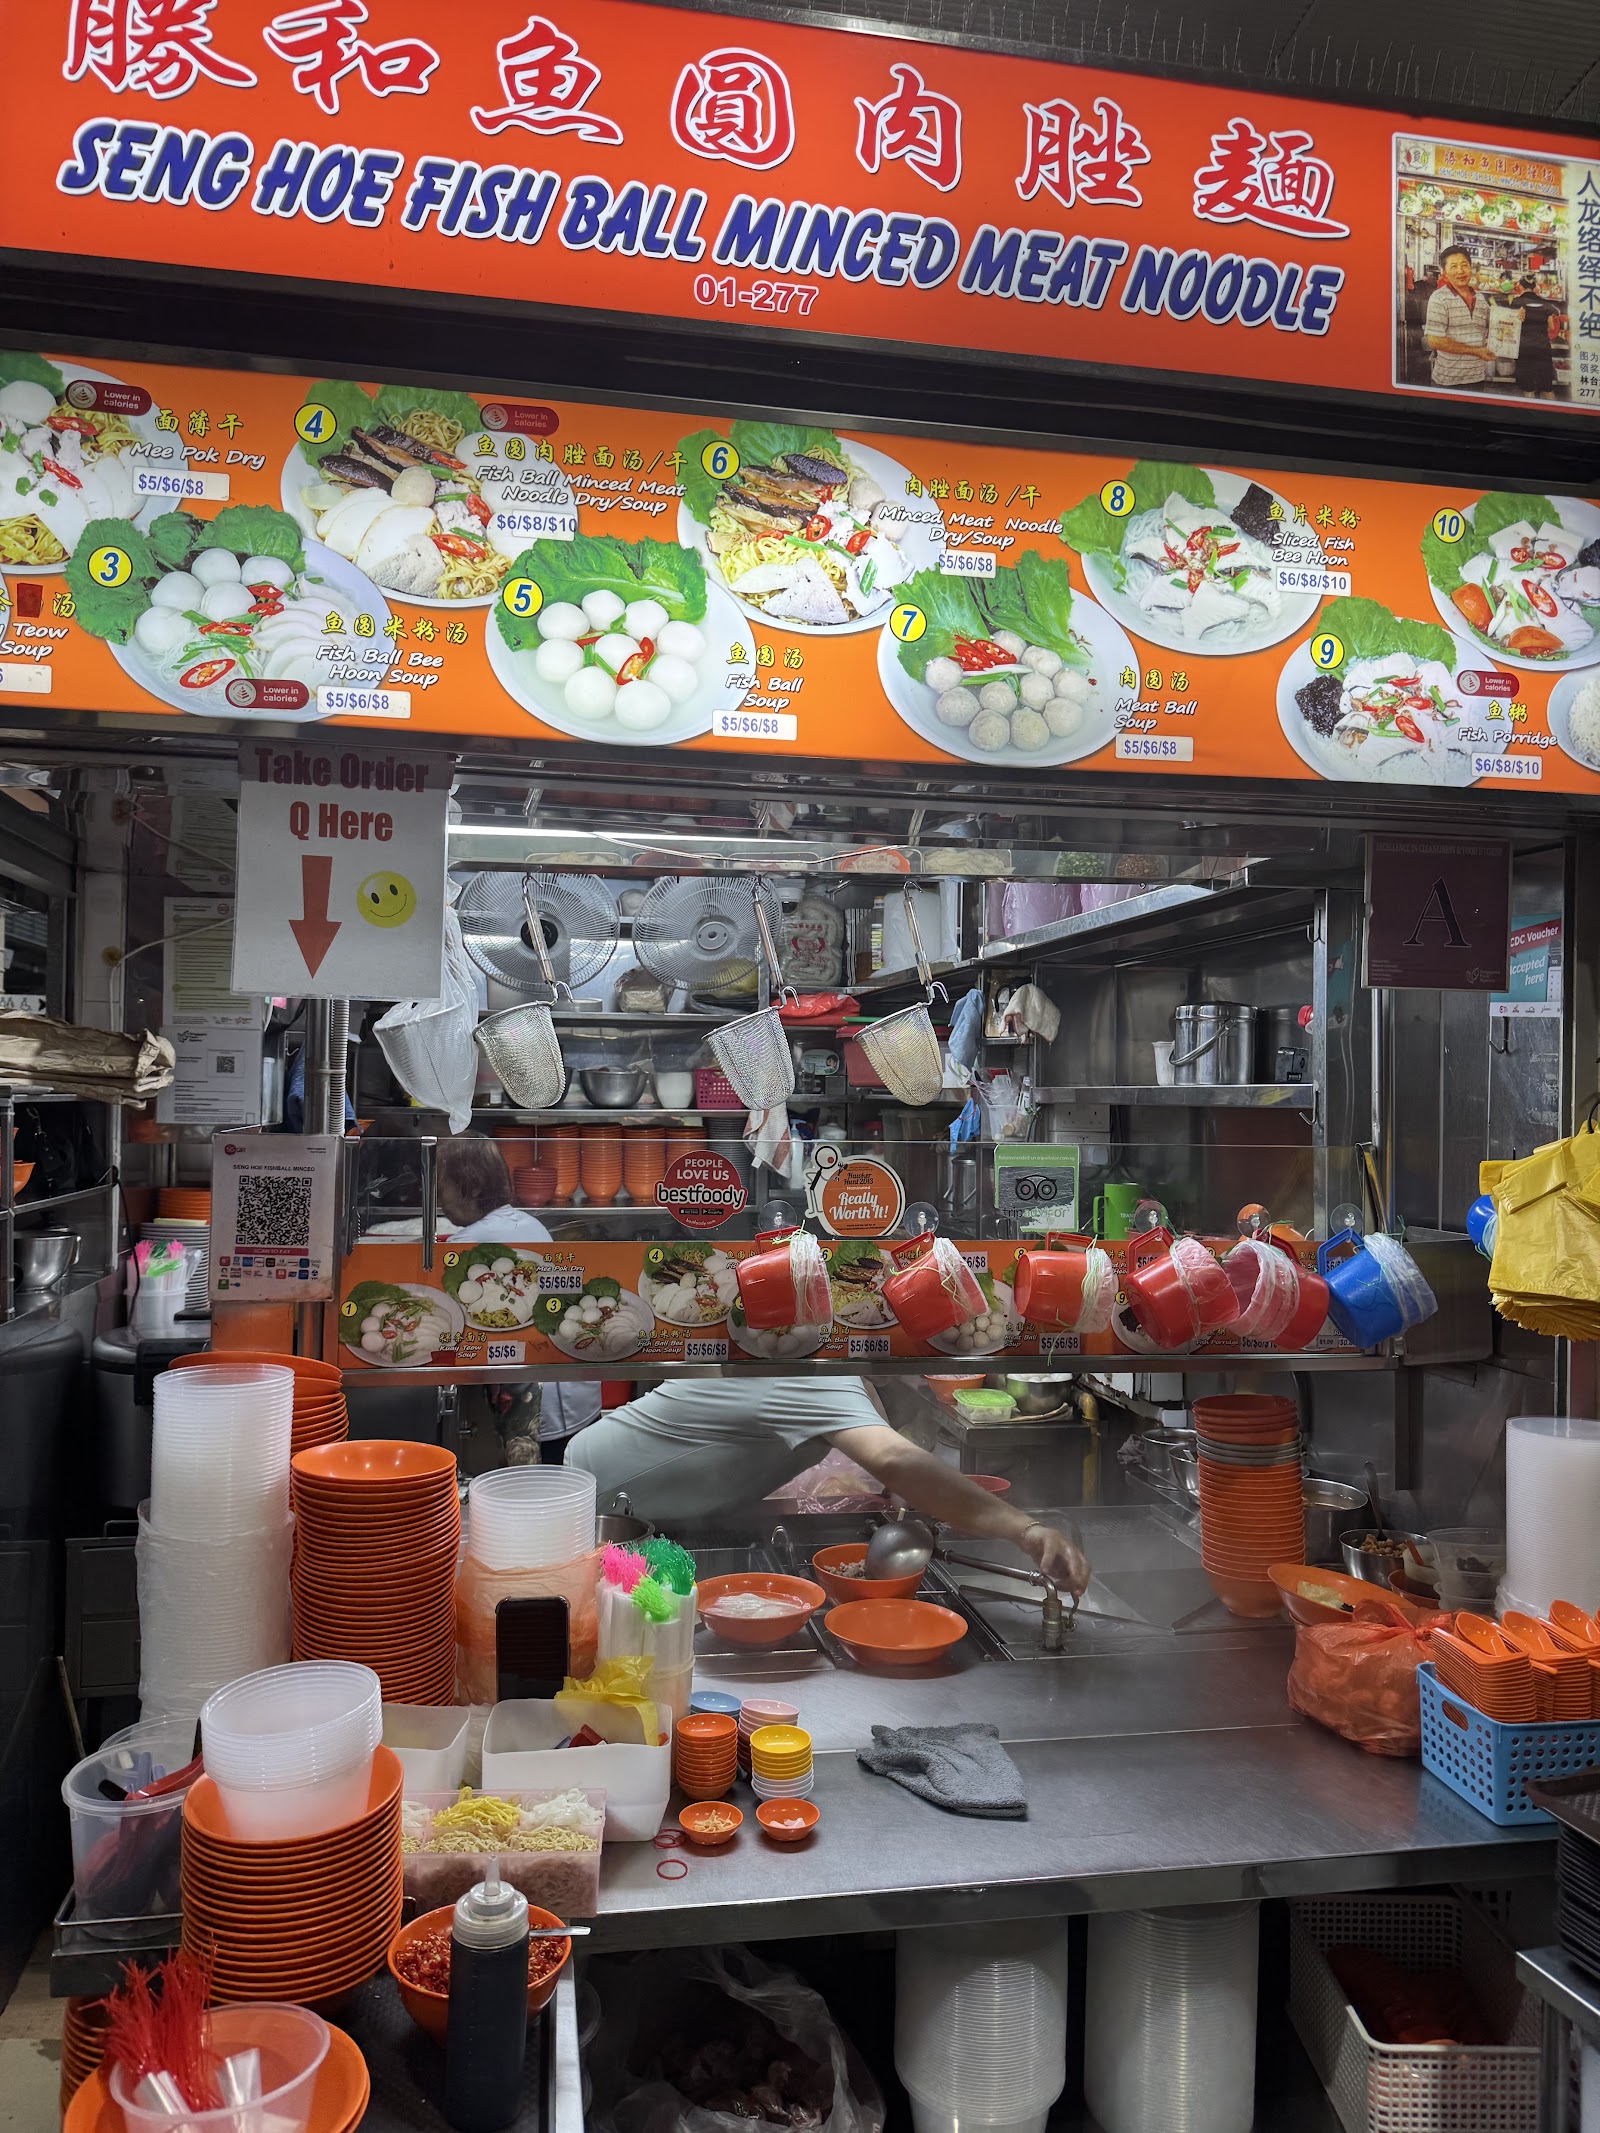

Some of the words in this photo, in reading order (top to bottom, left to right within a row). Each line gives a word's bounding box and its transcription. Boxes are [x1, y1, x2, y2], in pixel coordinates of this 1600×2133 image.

[57, 117, 255, 211] SENG
[252, 139, 402, 227] HOE
[400, 155, 558, 244] FISH
[558, 172, 711, 262] BALL
[712, 190, 956, 289] MINCED
[962, 224, 1130, 317] MEAT
[1124, 245, 1349, 338] NOODLE
[694, 274, 820, 316] 01-277
[1580, 375, 1600, 386] 林台
[103, 400, 139, 410] calories
[104, 390, 131, 400] Lower
[304, 411, 324, 438] 4
[514, 411, 539, 421] Lower
[541, 412, 548, 420] in
[514, 419, 547, 429] calories
[130, 443, 173, 460] Mee
[181, 447, 219, 463] Pok
[226, 451, 266, 471] Dry
[711, 446, 728, 474] 6
[138, 473, 204, 496] $5/$6/$8
[476, 465, 515, 483] Fish
[520, 468, 557, 487] Ball
[563, 472, 632, 493] Minced
[638, 478, 687, 497] Meat
[502, 485, 568, 506] Noodle
[575, 492, 668, 517] Dry/Soup
[1109, 485, 1125, 512] 8
[497, 513, 577, 533] $6/$8/$10
[879, 506, 943, 525] Minced
[948, 512, 994, 529] Meat
[1005, 517, 1064, 535] Noodle
[1437, 514, 1460, 537] 10
[929, 527, 1015, 551] Dry/Soup
[1272, 531, 1318, 549] Sliced
[1324, 537, 1355, 550] Fish
[99, 552, 118, 582] 3
[938, 553, 993, 573] $5/$6/$8
[1272, 549, 1301, 563] Bee
[1306, 552, 1349, 566] Hoon
[1279, 571, 1347, 590] $6/$8/$10
[514, 584, 533, 613] 5
[13, 622, 69, 640] Teow
[321, 610, 469, 645] 鱼圆米粉汤
[900, 610, 917, 637] 7
[0, 641, 54, 662] Soup
[316, 645, 355, 662] Fish
[363, 648, 402, 665] Ball
[409, 651, 444, 668] Bee
[726, 641, 804, 670] 鱼圆汤
[1320, 638, 1335, 665] 9
[329, 666, 382, 683] Hoon
[389, 669, 438, 690] Soup
[725, 673, 761, 690] Fish
[767, 676, 803, 693] Ball
[1118, 667, 1190, 692] 肉圆汤
[1485, 677, 1505, 686] Lower
[263, 685, 289, 694] Lower
[290, 686, 299, 694] in
[263, 693, 298, 703] calories
[1484, 684, 1511, 693] calories
[326, 693, 390, 710] $5/$6/$8
[744, 694, 789, 713] Soup
[1114, 698, 1159, 714] Meat
[1164, 700, 1198, 715] Ball
[721, 716, 779, 734] $5/$6/$8
[1114, 715, 1157, 734] Soup
[1124, 739, 1177, 756] $5/$6/$8
[1458, 728, 1488, 743] Fish
[1493, 730, 1558, 749] Porridge
[255, 748, 332, 786] Take
[340, 752, 429, 792] Order
[1475, 757, 1539, 775] $6/$8/$10
[289, 800, 310, 841] Q
[318, 803, 393, 842] Here
[1403, 877, 1472, 948] A
[1510, 934, 1525, 948] CDC
[1527, 926, 1559, 942] Voucher
[1525, 971, 1545, 986] here
[684, 1158, 723, 1169] PEOPLE
[676, 1169, 710, 1181] LOVE
[713, 1169, 729, 1181] US
[657, 1184, 744, 1209] bestfoody
[838, 1192, 879, 1208] Really
[829, 1205, 871, 1221] Worth
[539, 1276, 581, 1289] $5/$6/$8
[488, 1345, 516, 1359] $5/$6
[686, 1343, 727, 1356] $5/$6/$8
[850, 1339, 889, 1353] $5/$6/$8
